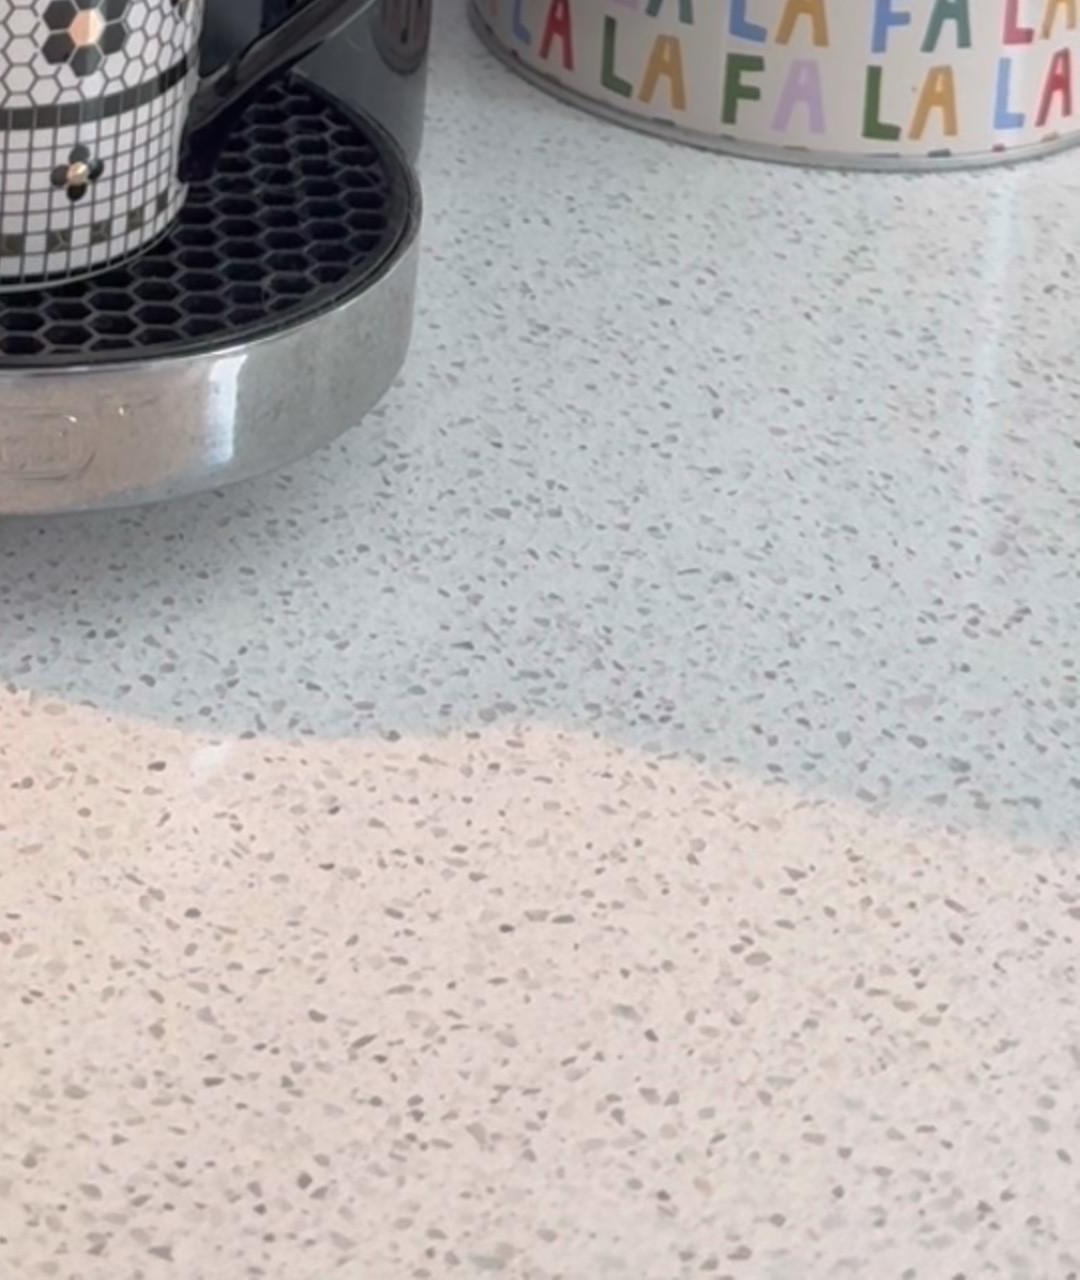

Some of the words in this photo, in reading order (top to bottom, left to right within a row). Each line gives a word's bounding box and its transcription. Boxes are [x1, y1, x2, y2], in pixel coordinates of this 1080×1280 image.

[601, 16, 686, 112] LA
[721, 53, 825, 134] FA
[861, 65, 958, 141] LA
[993, 47, 1073, 132] LA
